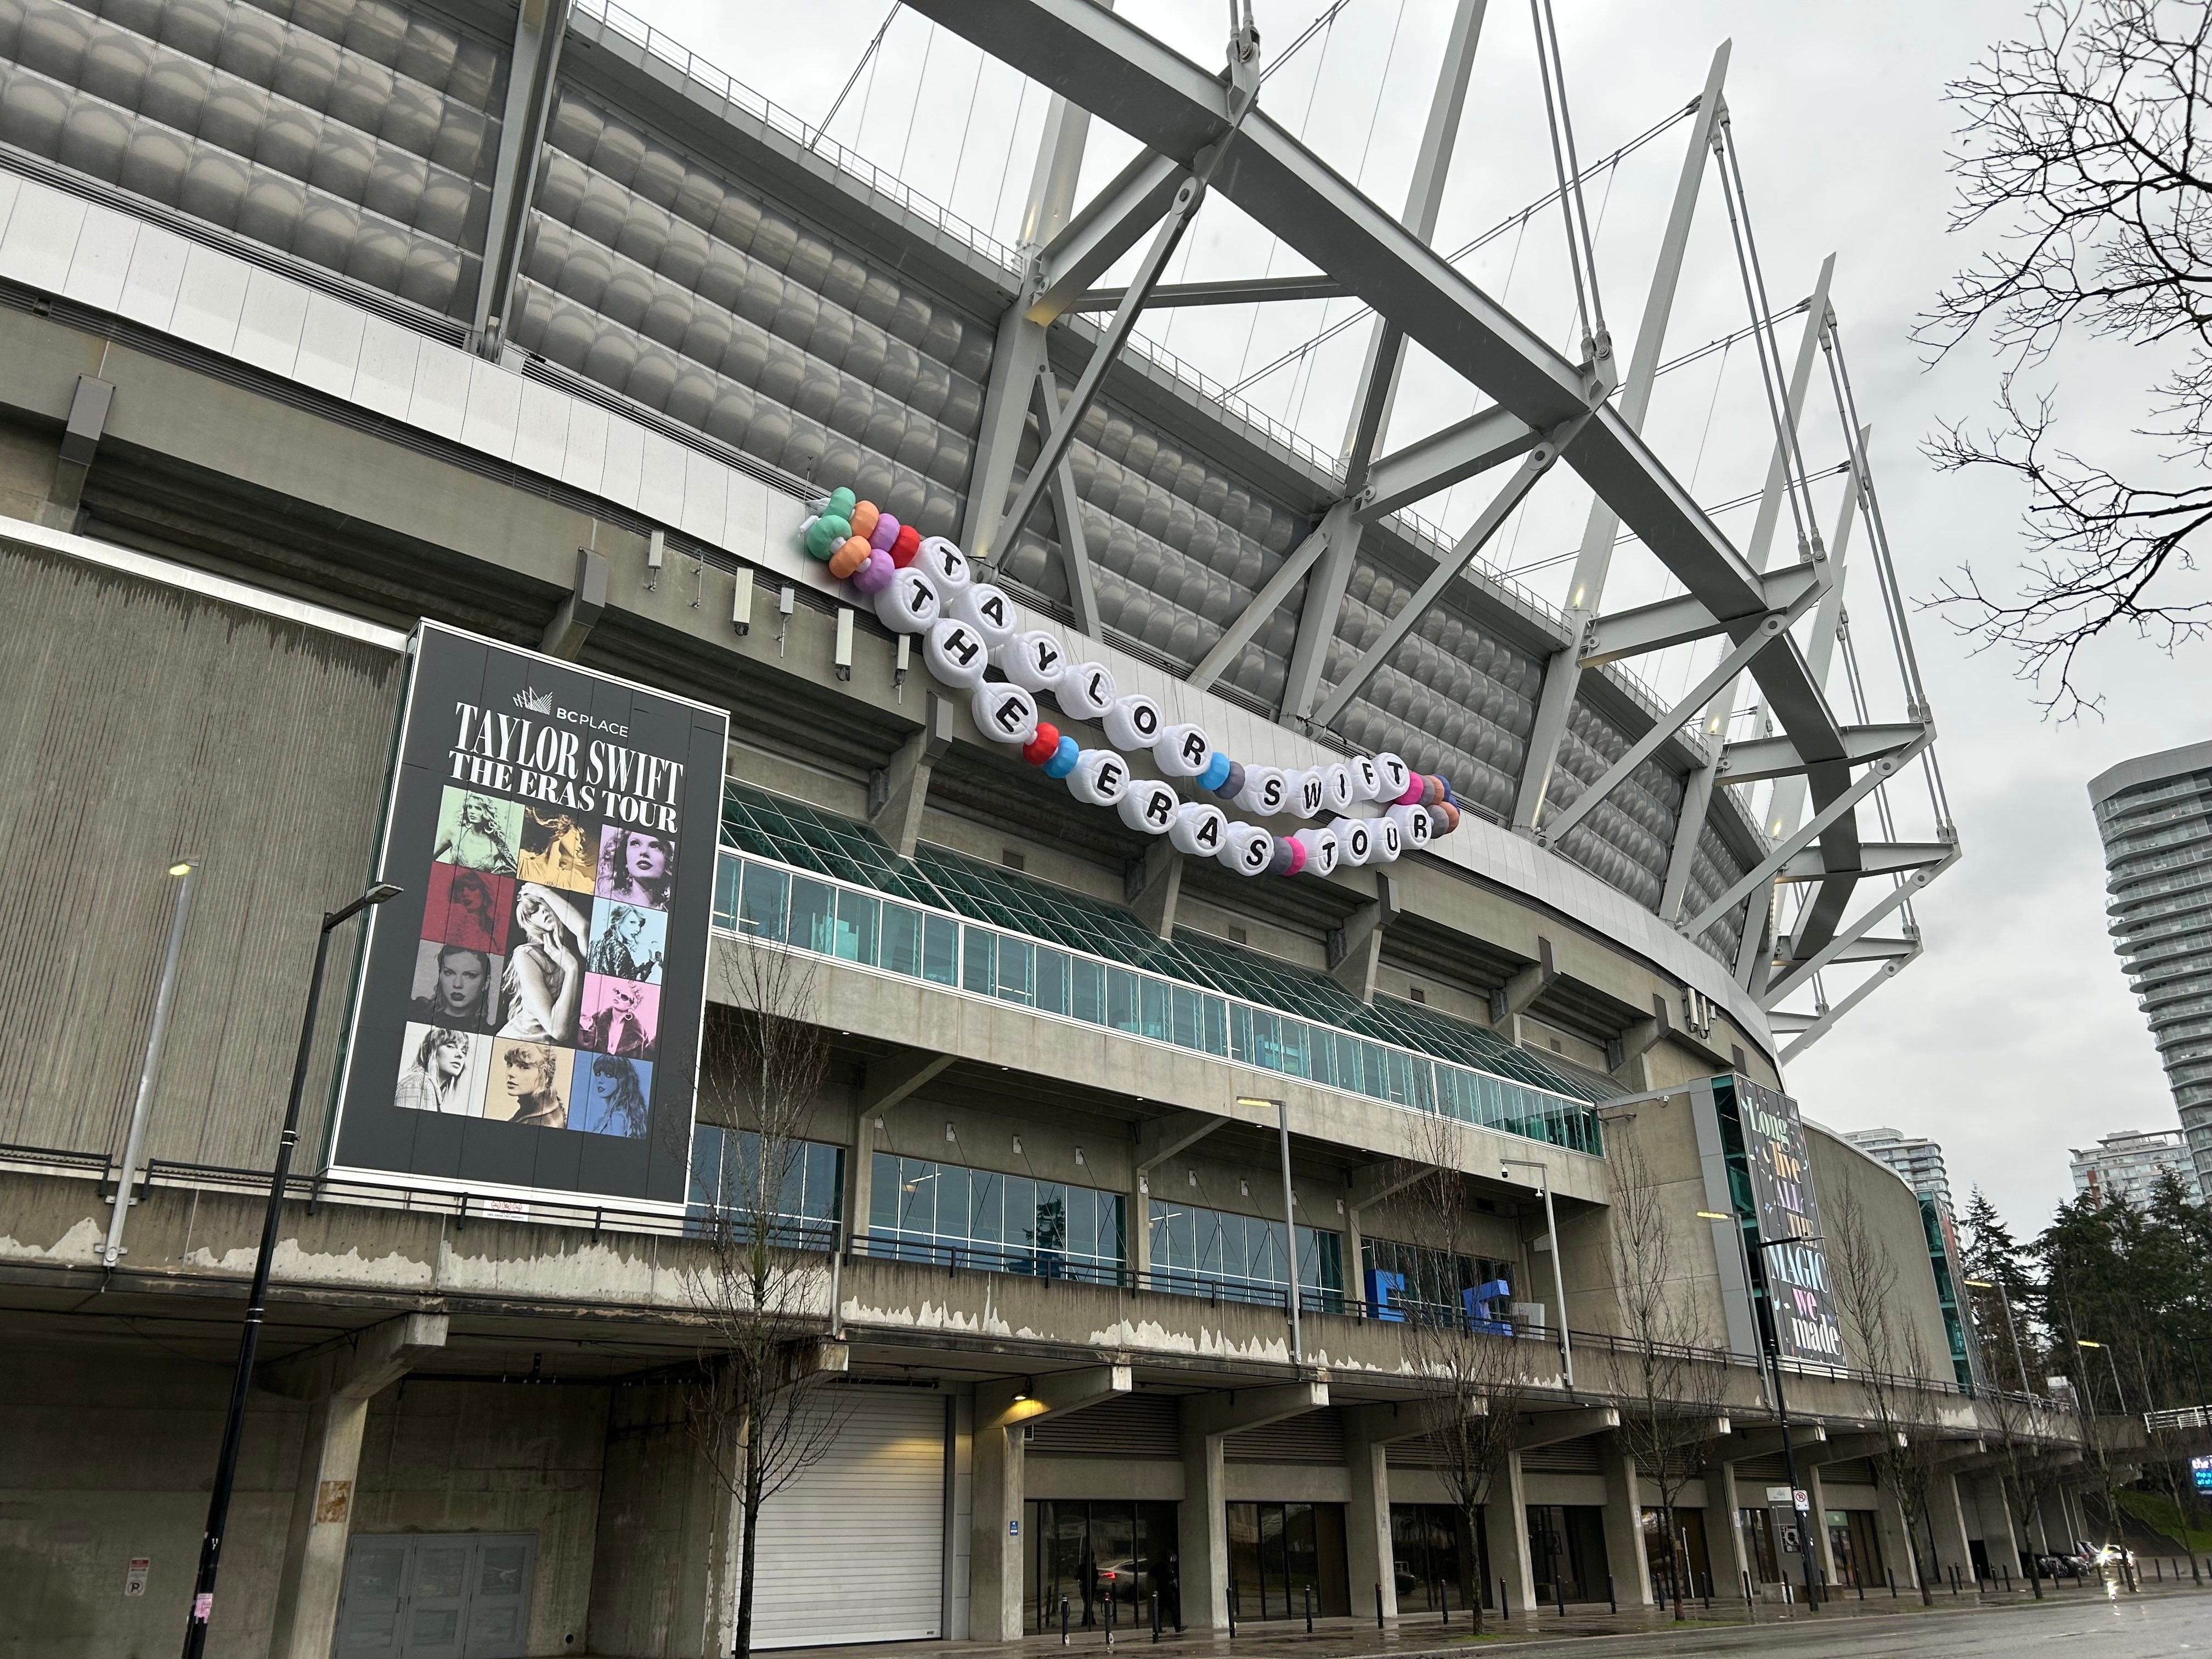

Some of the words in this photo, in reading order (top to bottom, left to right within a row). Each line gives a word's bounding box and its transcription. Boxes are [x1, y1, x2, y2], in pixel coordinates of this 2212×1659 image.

[940, 546, 1205, 766] TAYLOR
[1263, 761, 1403, 810] SWIFT
[911, 579, 1029, 732] THE
[1097, 763, 1267, 866] ERAS
[1322, 814, 1426, 867] TOUR
[455, 701, 579, 780] TAYLOR
[586, 739, 684, 805] SWIFT
[449, 750, 513, 792] THE
[517, 769, 596, 812] ERAS
[602, 790, 678, 834] TOUR
[1746, 1096, 1790, 1152] Long
[1772, 1141, 1802, 1184] live
[1777, 1178, 1804, 1214] ALL
[1764, 1236, 1829, 1294] MAGIC
[1792, 1288, 1819, 1321] we
[1791, 1313, 1841, 1356] made
